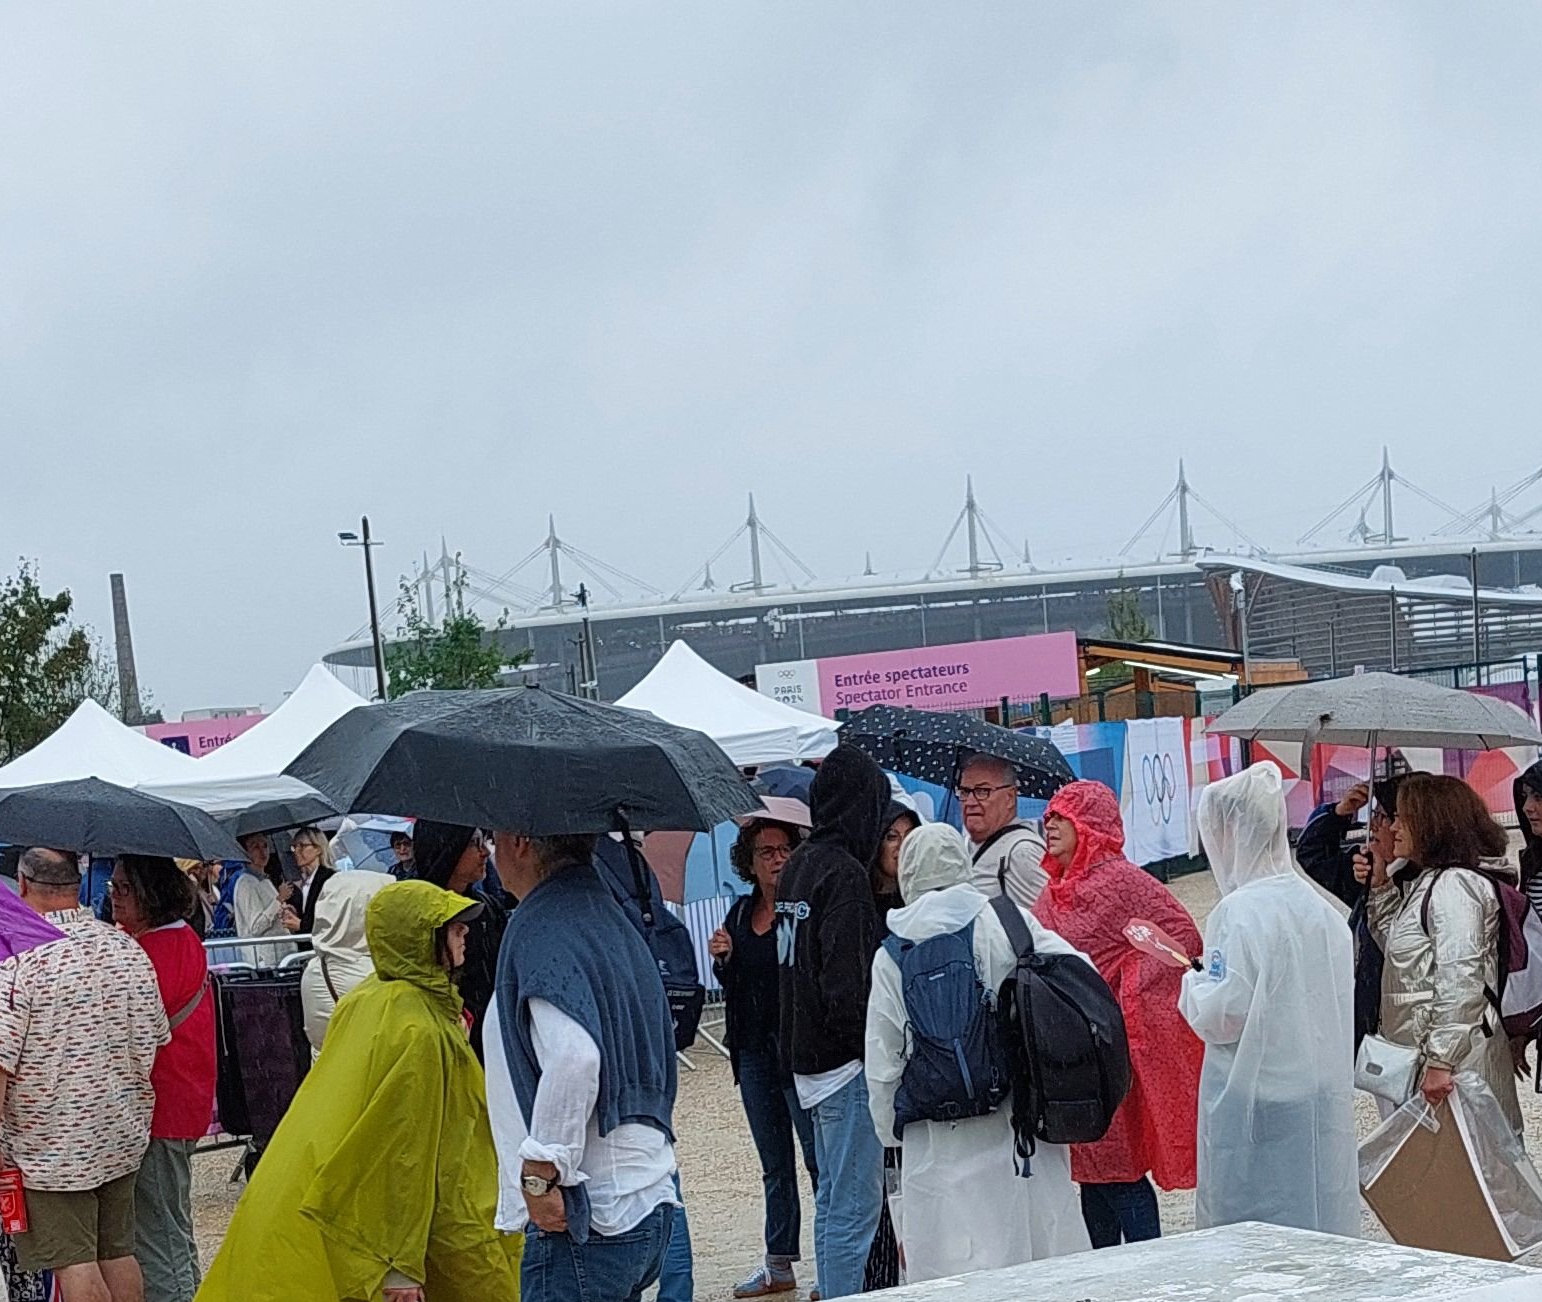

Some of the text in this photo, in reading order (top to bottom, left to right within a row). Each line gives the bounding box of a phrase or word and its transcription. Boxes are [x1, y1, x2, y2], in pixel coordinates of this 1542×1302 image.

[834, 662, 970, 688] Entrée spectateurs
[835, 680, 969, 706] Spectator Entrance
